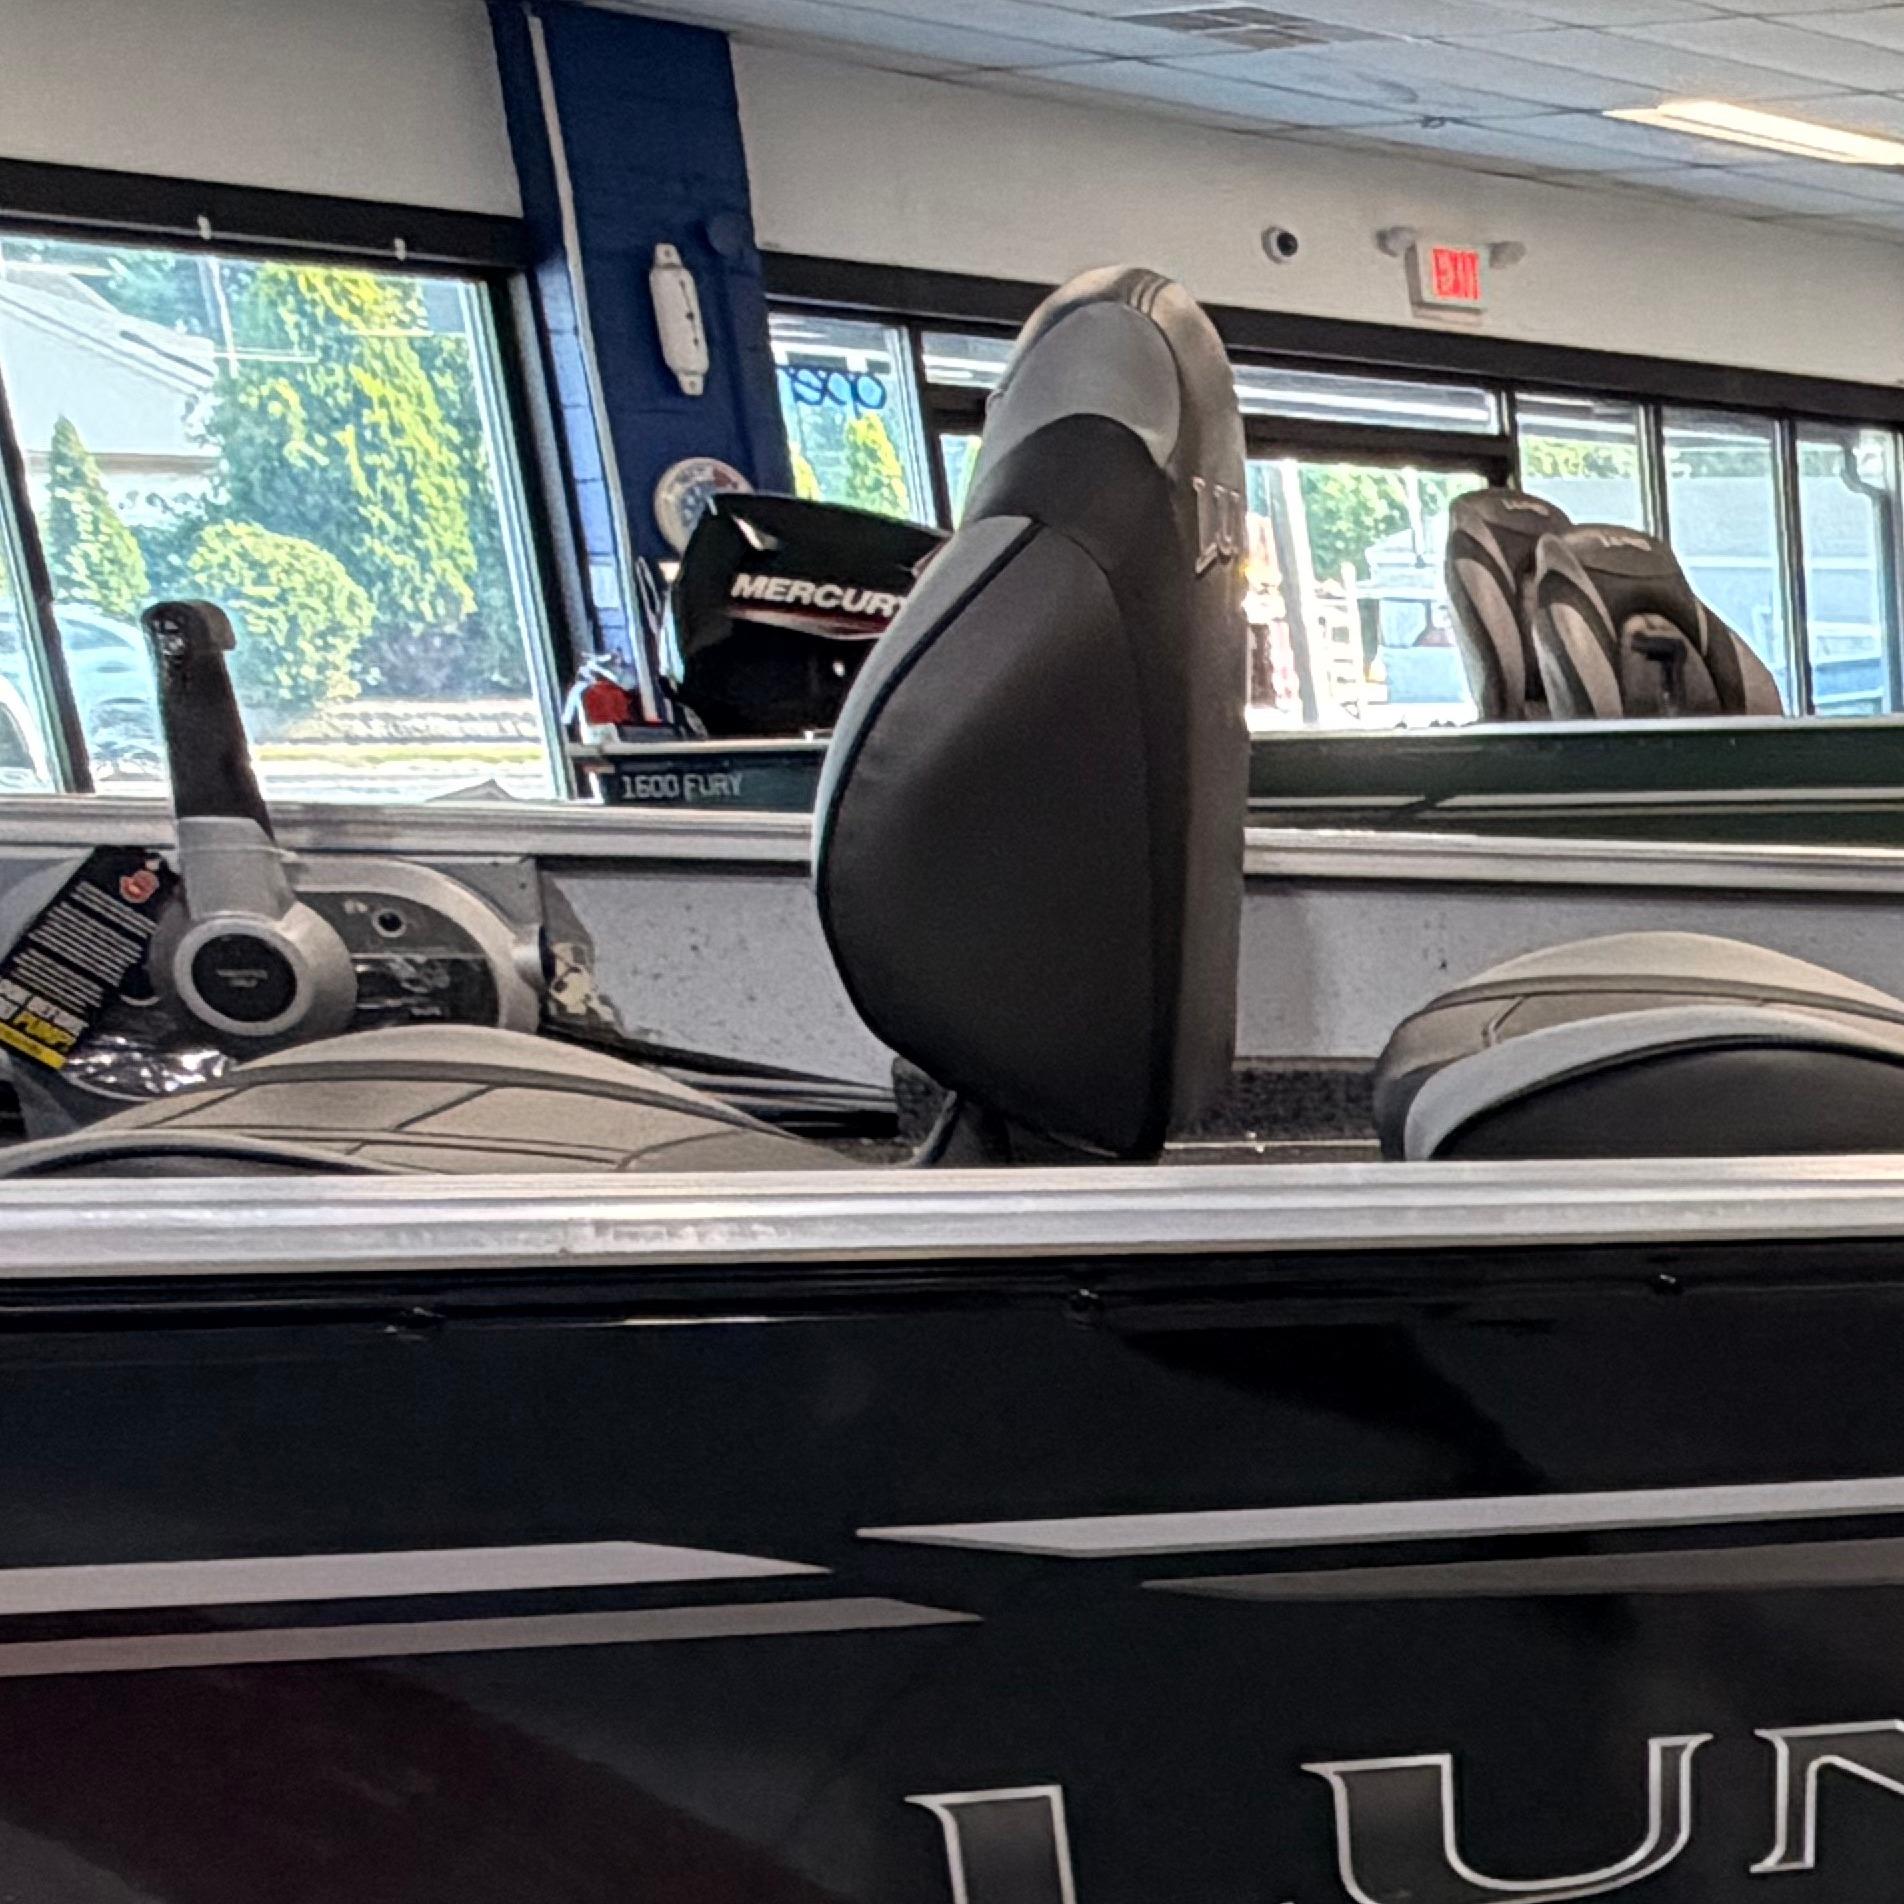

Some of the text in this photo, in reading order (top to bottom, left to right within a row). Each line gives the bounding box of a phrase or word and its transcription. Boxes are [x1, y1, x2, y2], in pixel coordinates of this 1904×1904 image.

[1432, 248, 1479, 300] EXIT
[731, 573, 907, 617] MERCUR
[621, 773, 743, 802] 1600 FURY
